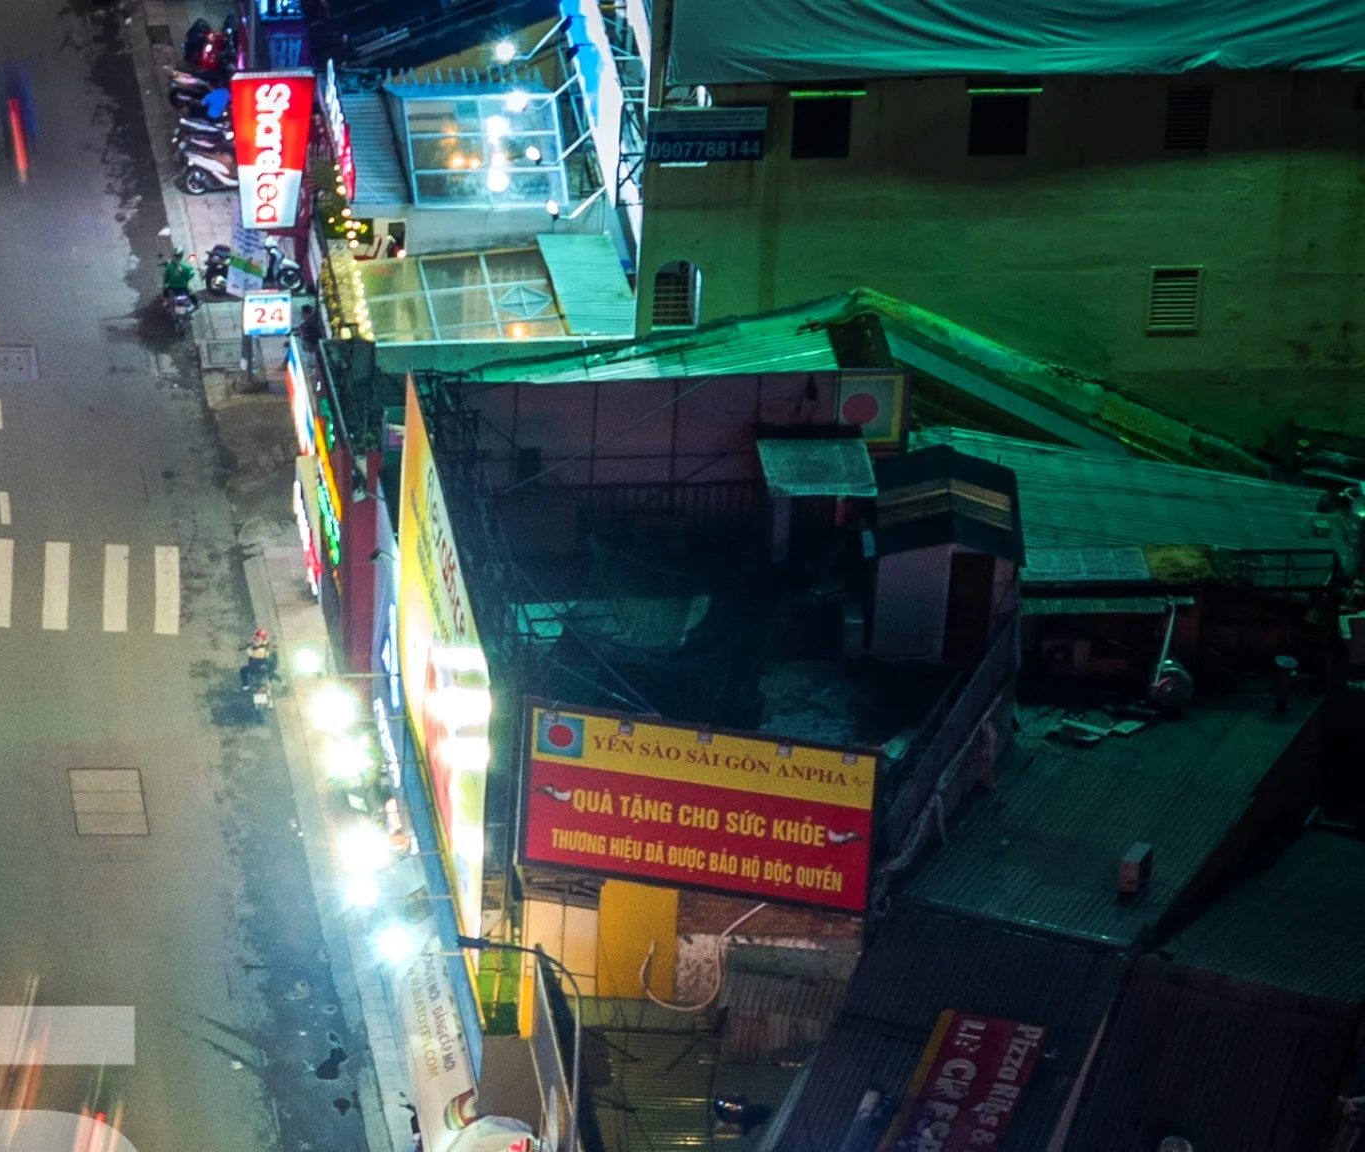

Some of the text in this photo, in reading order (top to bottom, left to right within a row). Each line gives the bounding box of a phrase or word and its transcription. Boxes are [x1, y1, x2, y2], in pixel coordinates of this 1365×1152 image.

[650, 140, 760, 158] 0907788144
[254, 308, 284, 324] 24
[593, 734, 849, 787] YẾN SÀO SÀI GÒN ANPHA
[573, 786, 827, 848] QUÀ TẶNG CHO SỨC KHỎE
[551, 828, 606, 855] THƯƠNG
[610, 834, 642, 861] HIỆU
[668, 847, 705, 872] ĐƯỢC
[709, 848, 737, 875] BẢO
[740, 854, 760, 882] HỘ
[764, 859, 794, 886] ĐỘC
[796, 863, 842, 892] QUYỀN
[996, 1024, 1044, 1081] Pizza
[970, 1129, 996, 1146] &
